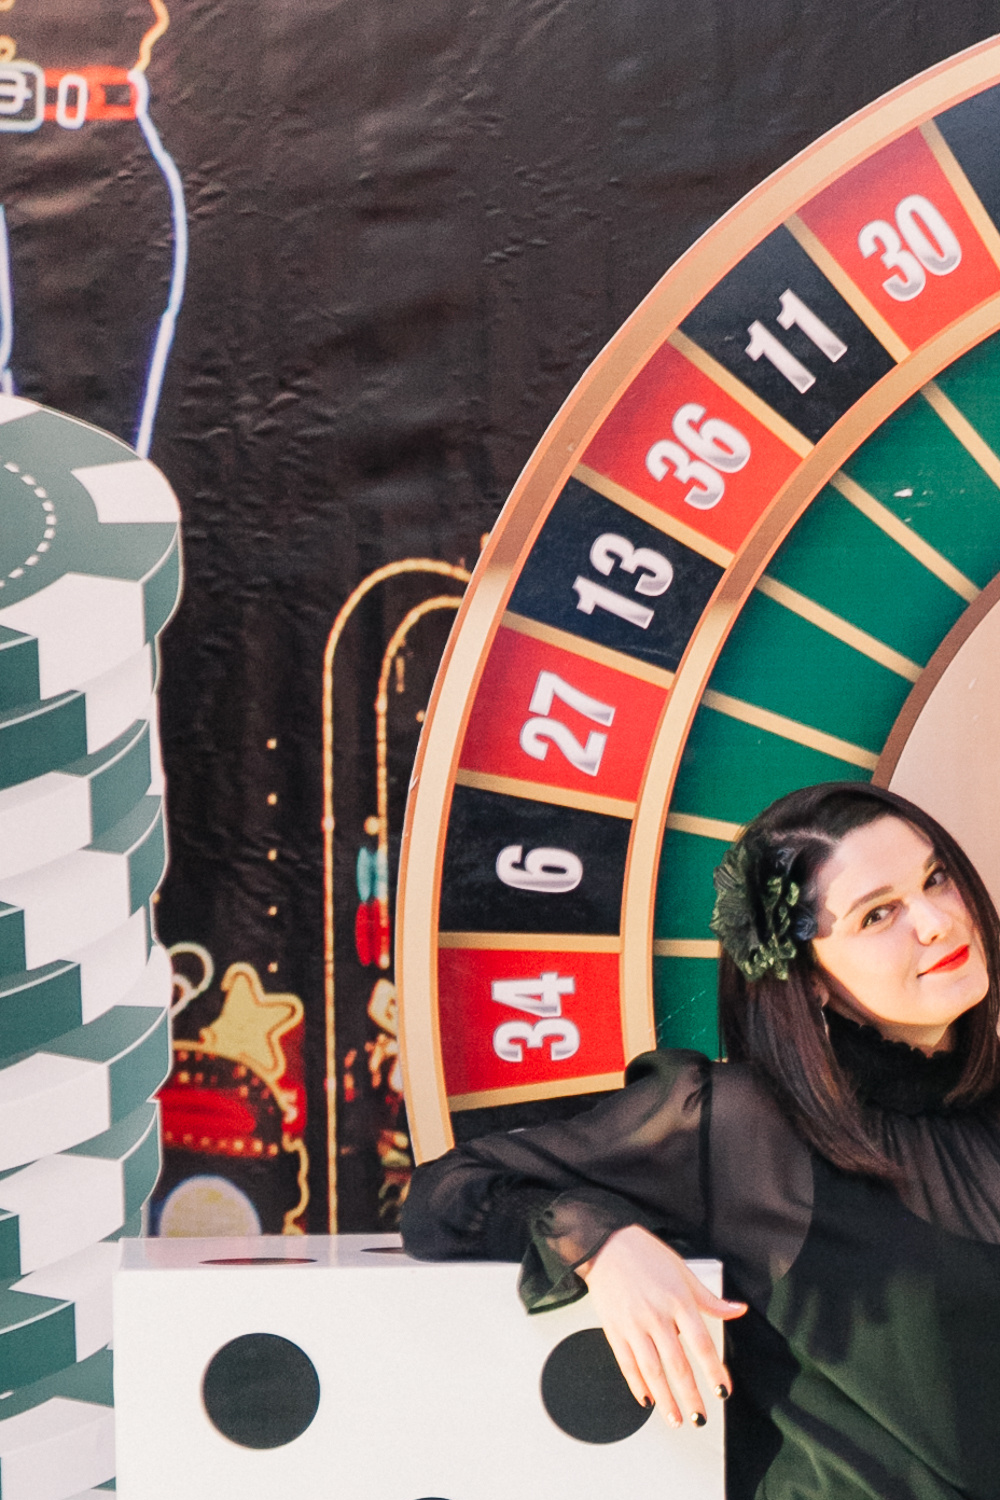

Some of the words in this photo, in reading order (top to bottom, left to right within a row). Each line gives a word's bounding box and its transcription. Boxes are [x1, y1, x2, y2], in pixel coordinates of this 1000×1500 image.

[857, 194, 963, 302] 30
[745, 289, 848, 394] 11
[646, 402, 752, 511] 36
[572, 532, 674, 630] 13
[519, 670, 617, 777] 27
[495, 844, 584, 893] 6
[491, 971, 581, 1063] 34
